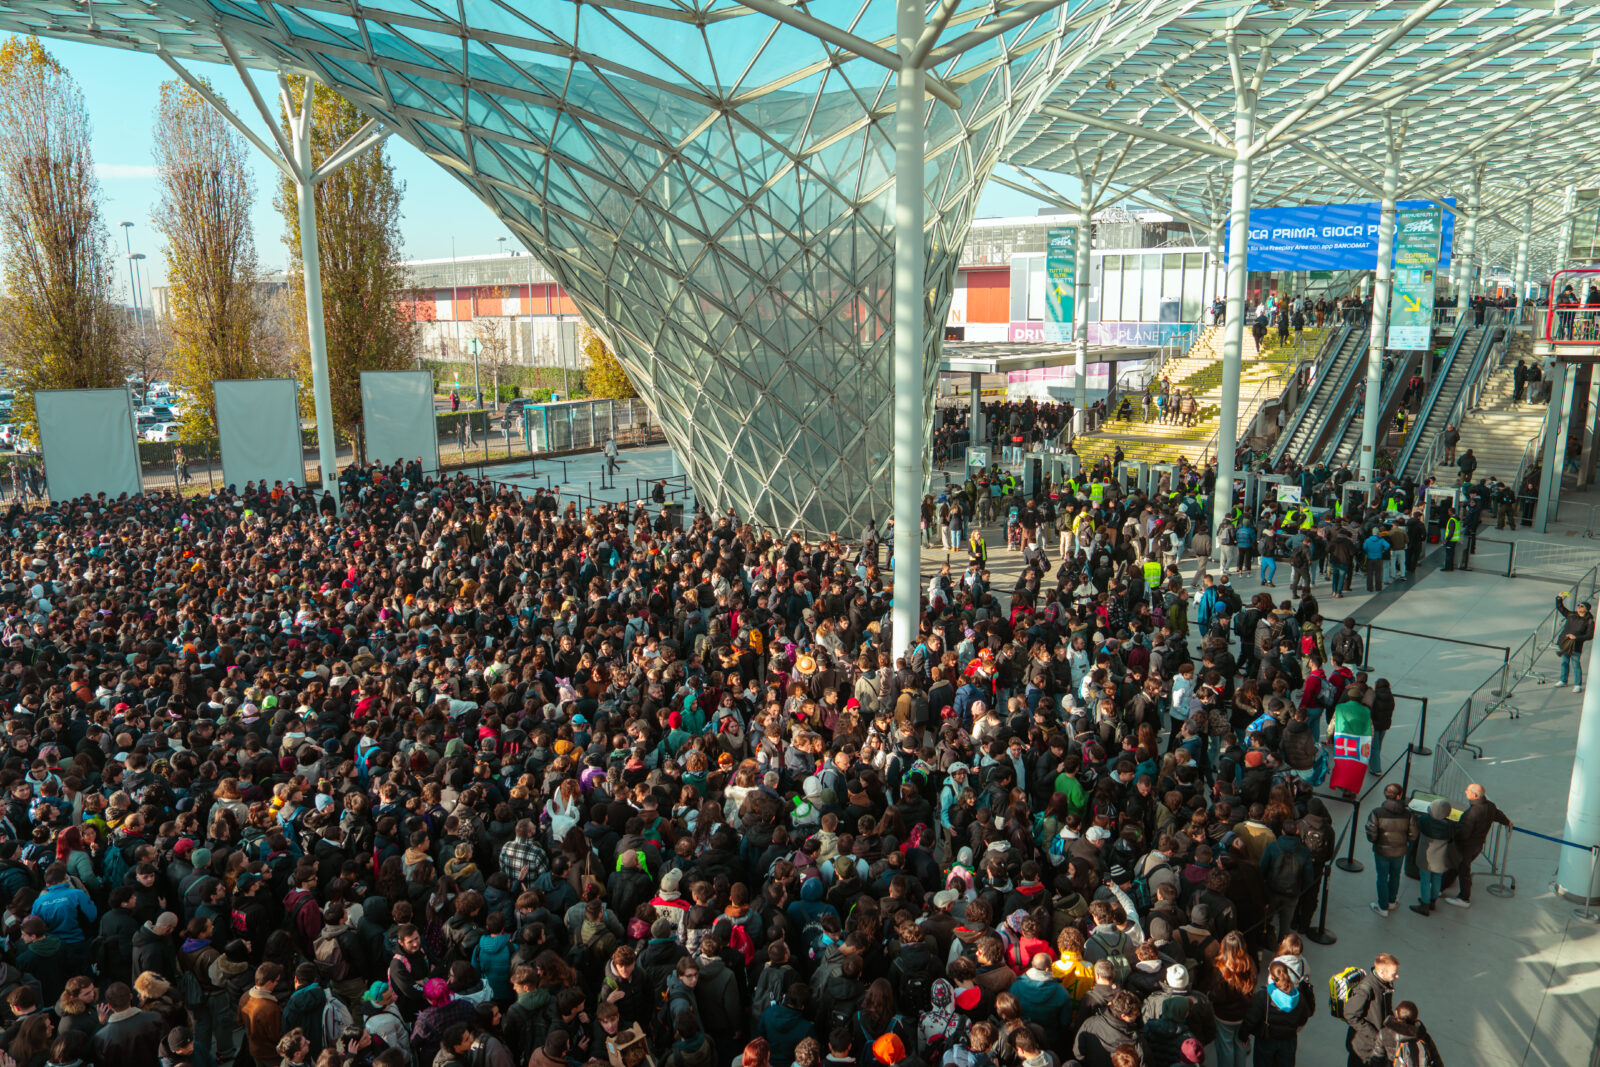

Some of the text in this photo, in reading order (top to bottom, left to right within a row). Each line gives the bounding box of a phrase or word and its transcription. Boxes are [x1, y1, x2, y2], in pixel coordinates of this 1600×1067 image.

[1272, 227, 1318, 239] PRIMA.
[1322, 225, 1363, 237] GIOCA
[1269, 244, 1294, 252] Freeplay
[1119, 329, 1168, 342] PLANET
